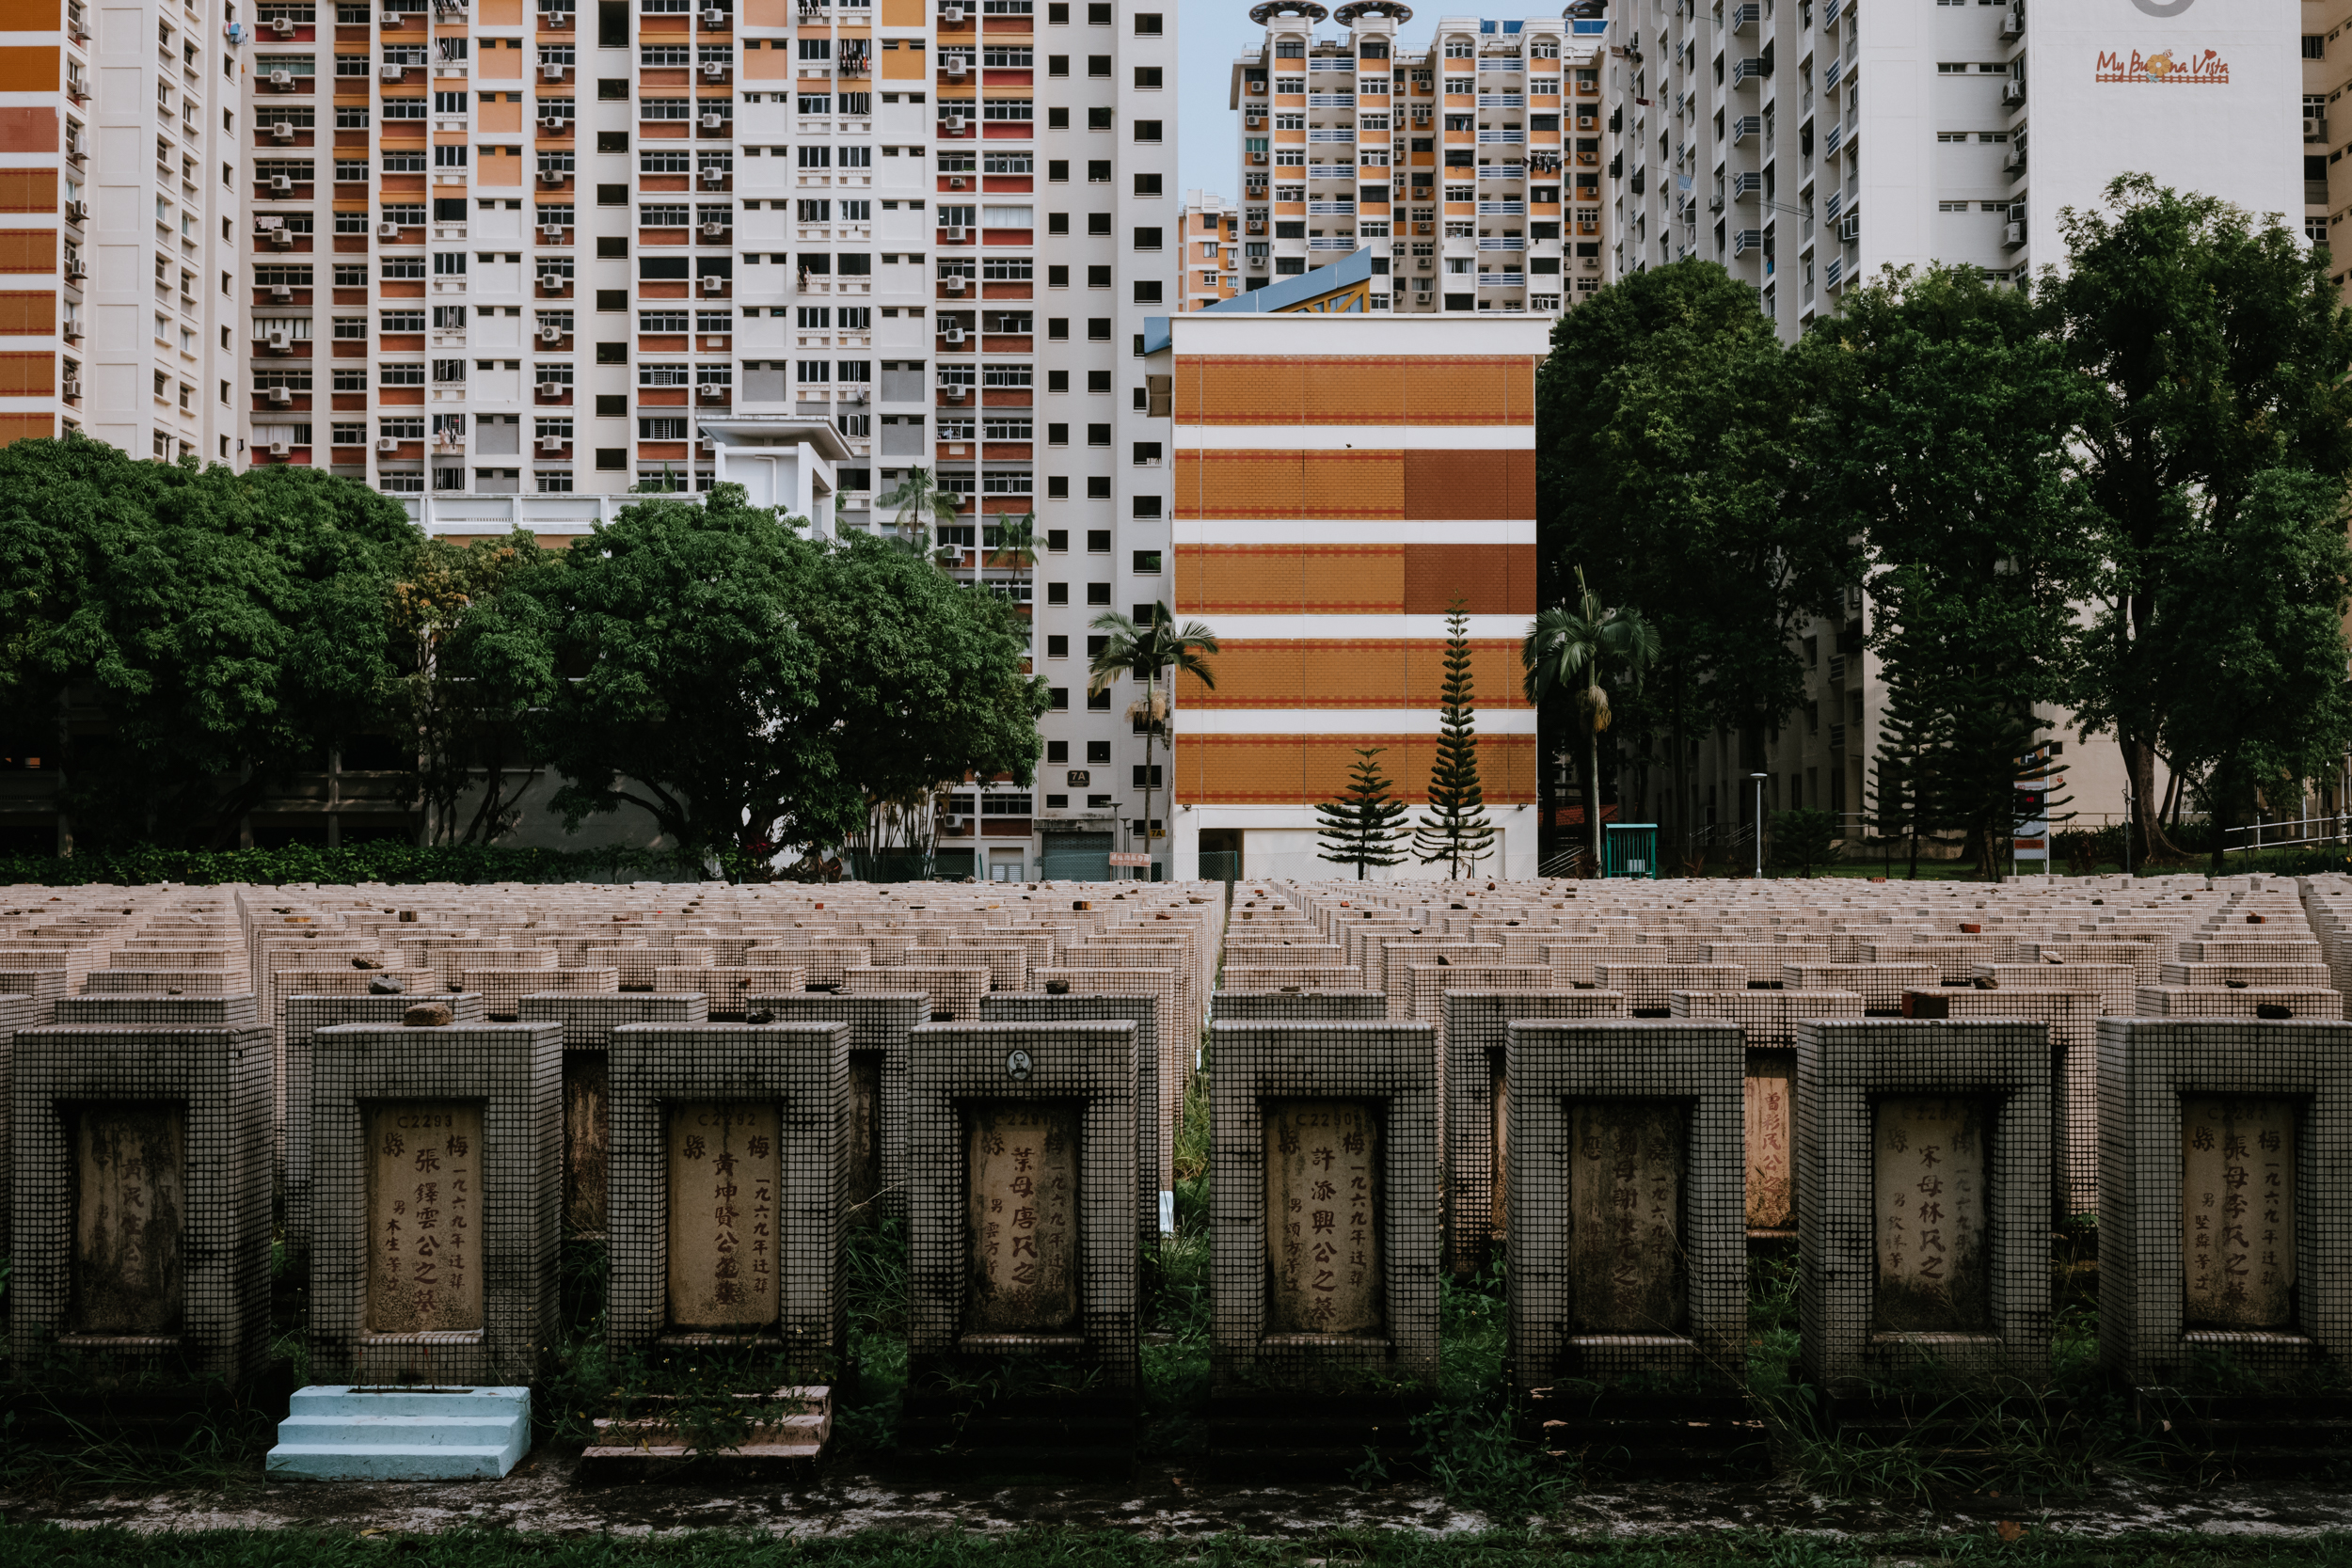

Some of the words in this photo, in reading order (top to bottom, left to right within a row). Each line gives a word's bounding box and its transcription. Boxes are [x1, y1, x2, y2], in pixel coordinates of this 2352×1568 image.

[2097, 51, 2125, 82] My
[2193, 49, 2230, 77] Vista
[1071, 771, 1086, 781] 7A
[397, 1114, 453, 1129] C2293
[698, 1113, 755, 1126] C2292
[1295, 1113, 1352, 1127] C2290
